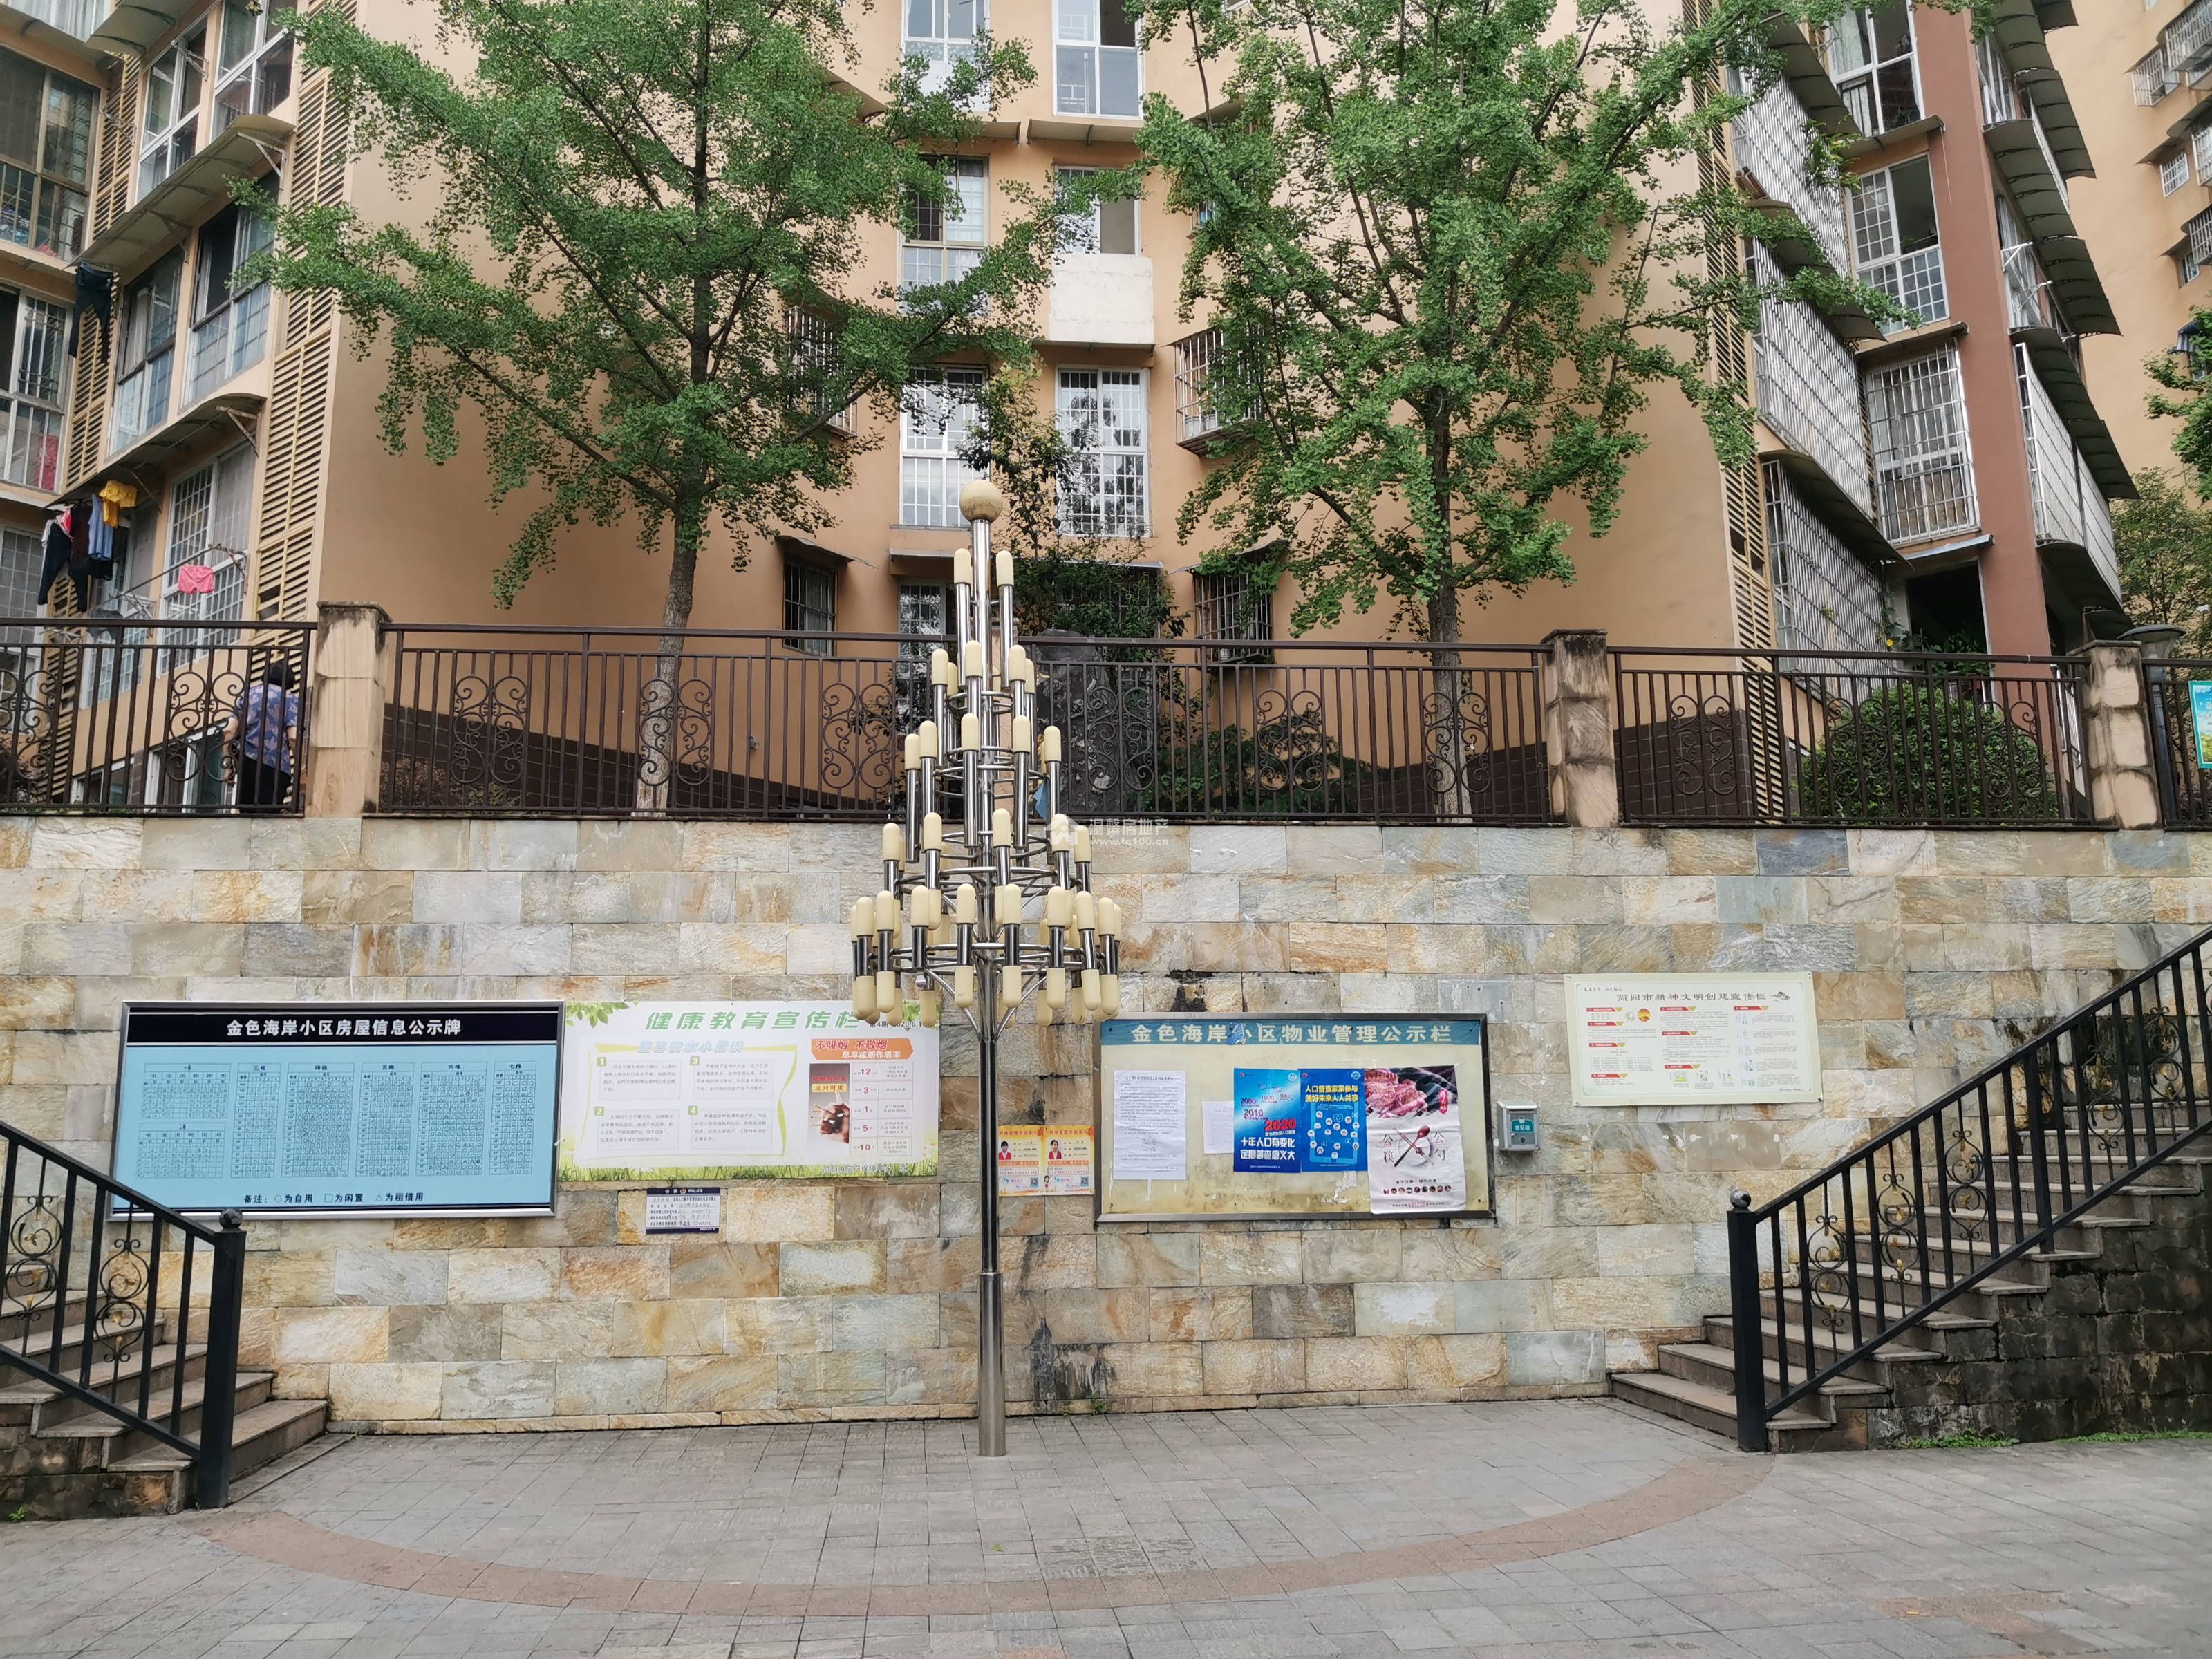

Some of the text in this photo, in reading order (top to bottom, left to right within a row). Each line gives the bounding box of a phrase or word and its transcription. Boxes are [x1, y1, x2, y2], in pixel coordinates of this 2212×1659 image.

[1616, 993, 1766, 1002] 简阳市精神文明创建宣传栏
[645, 1011, 860, 1030] 健康教育宣传栏
[227, 1019, 461, 1036] 金色海岸小区房屋信息公示牌
[815, 1040, 848, 1050] 不吸烟
[1264, 1118, 1296, 1131] 2020
[1240, 1137, 1295, 1147] 十年人口有变化
[1240, 1149, 1295, 1160] 定期普查意义大
